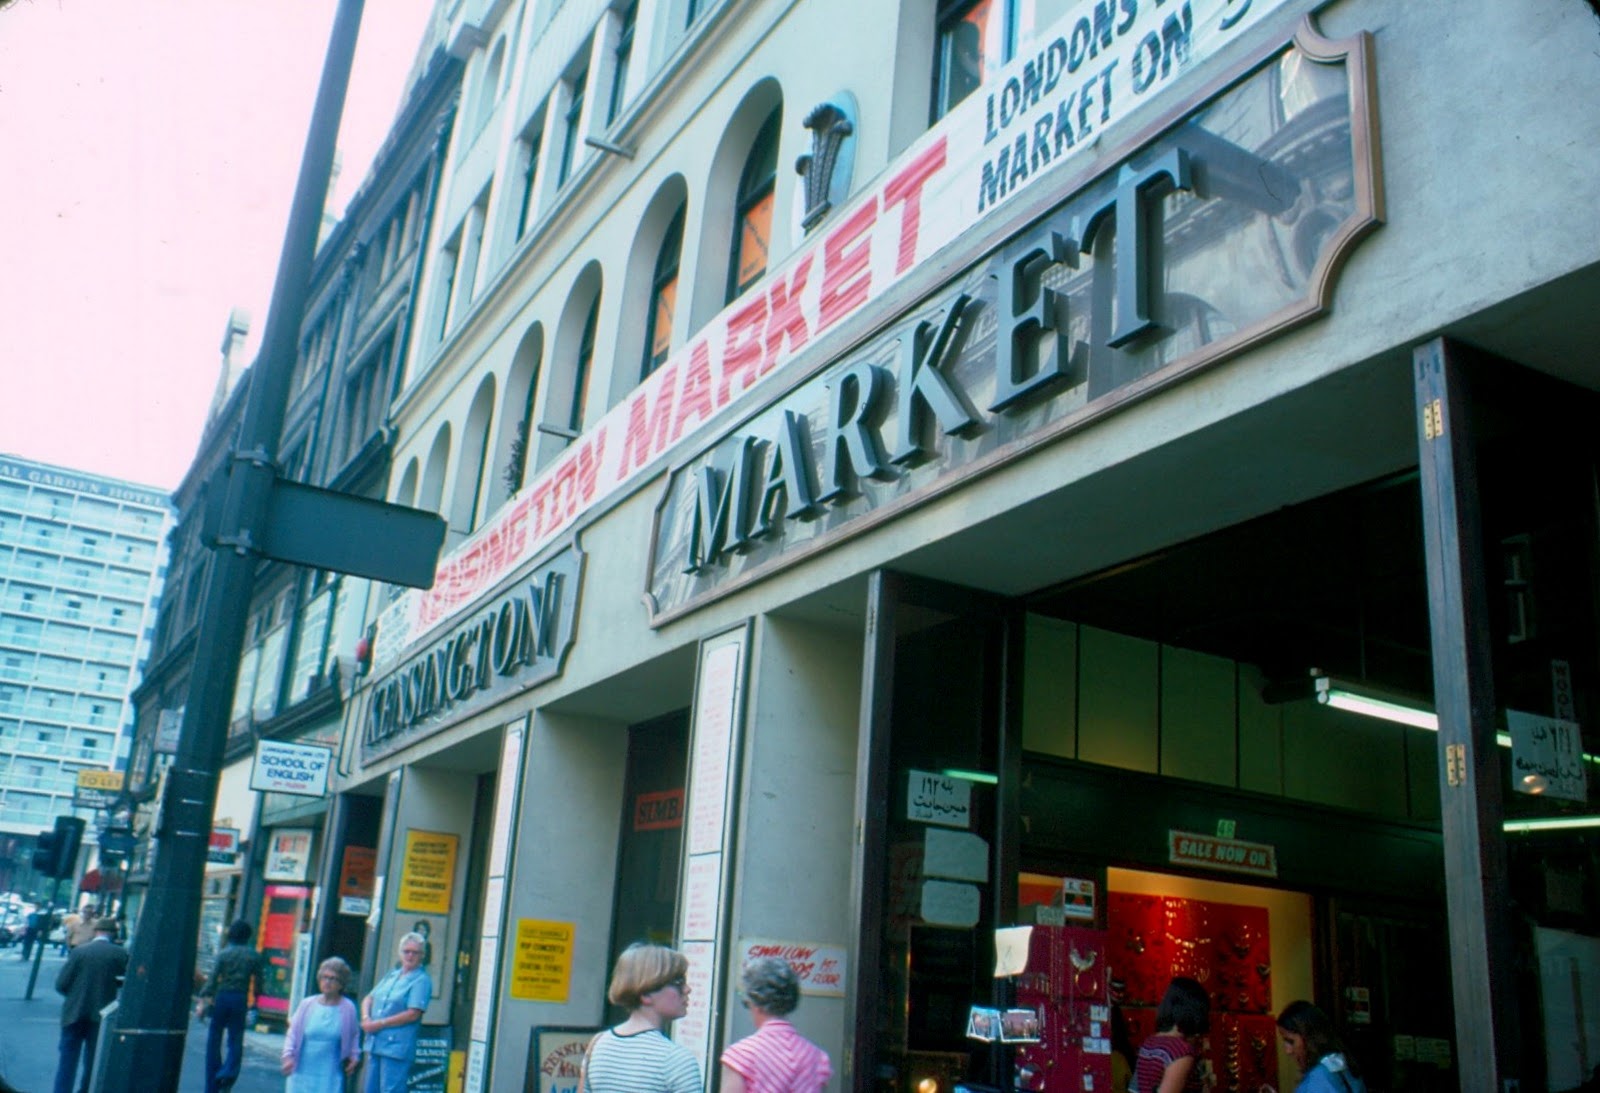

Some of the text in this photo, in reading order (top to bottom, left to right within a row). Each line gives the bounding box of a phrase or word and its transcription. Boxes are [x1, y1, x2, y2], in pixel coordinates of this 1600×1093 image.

[977, 0, 1194, 214] MARKET ON
[616, 135, 948, 482] MARKET
[366, 146, 1193, 746] KENSINGTON MARKET
[28, 471, 101, 493] GARDEN
[109, 487, 162, 506] HOTEL
[261, 755, 326, 771] SCHOOL OF
[266, 768, 315, 782] ENGLISH
[81, 774, 122, 788] TO LET
[1179, 839, 1267, 867] SALE NOW ON
